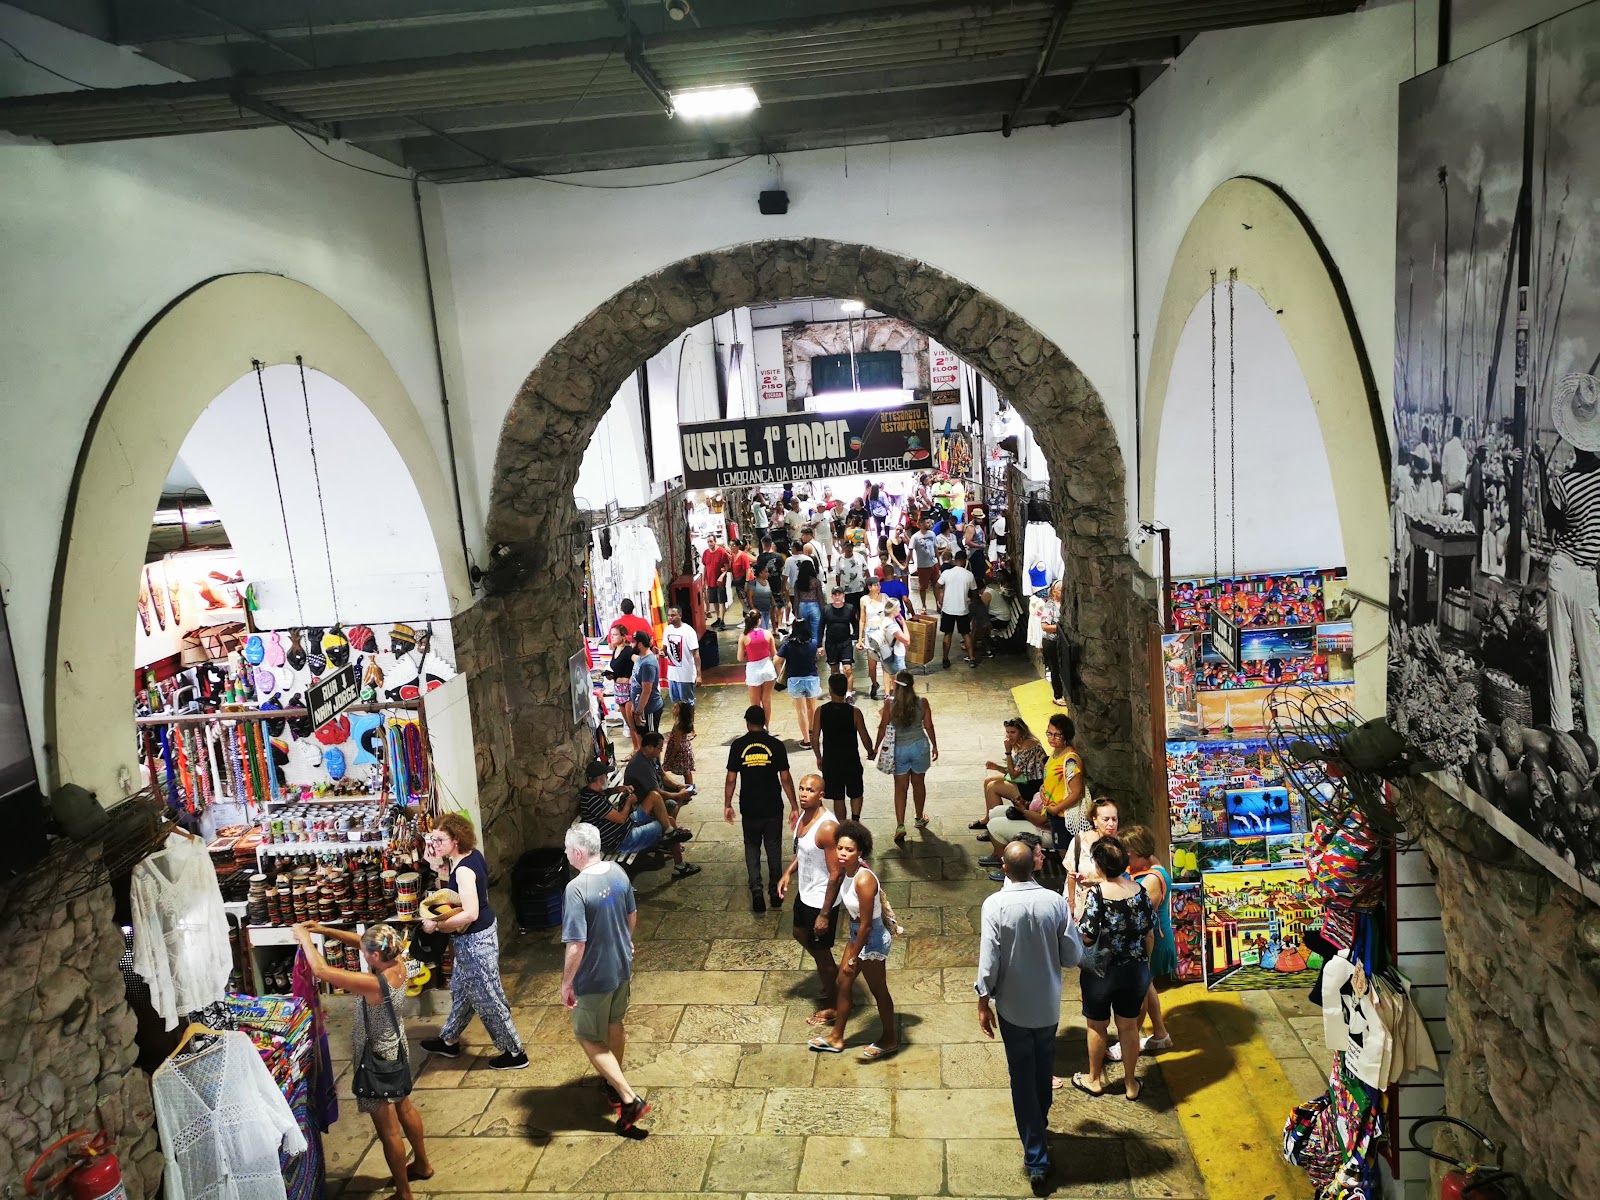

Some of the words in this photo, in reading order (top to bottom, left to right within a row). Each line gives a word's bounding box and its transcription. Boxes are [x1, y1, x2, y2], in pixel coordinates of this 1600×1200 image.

[936, 355, 954, 366] 2nd
[683, 428, 749, 472] VISITE
[776, 467, 789, 482] DA
[791, 464, 819, 480] BAHIA
[828, 460, 859, 477] ANDAR
[861, 459, 869, 474] E
[321, 679, 338, 701] RUA
[333, 683, 357, 713] JORGE
